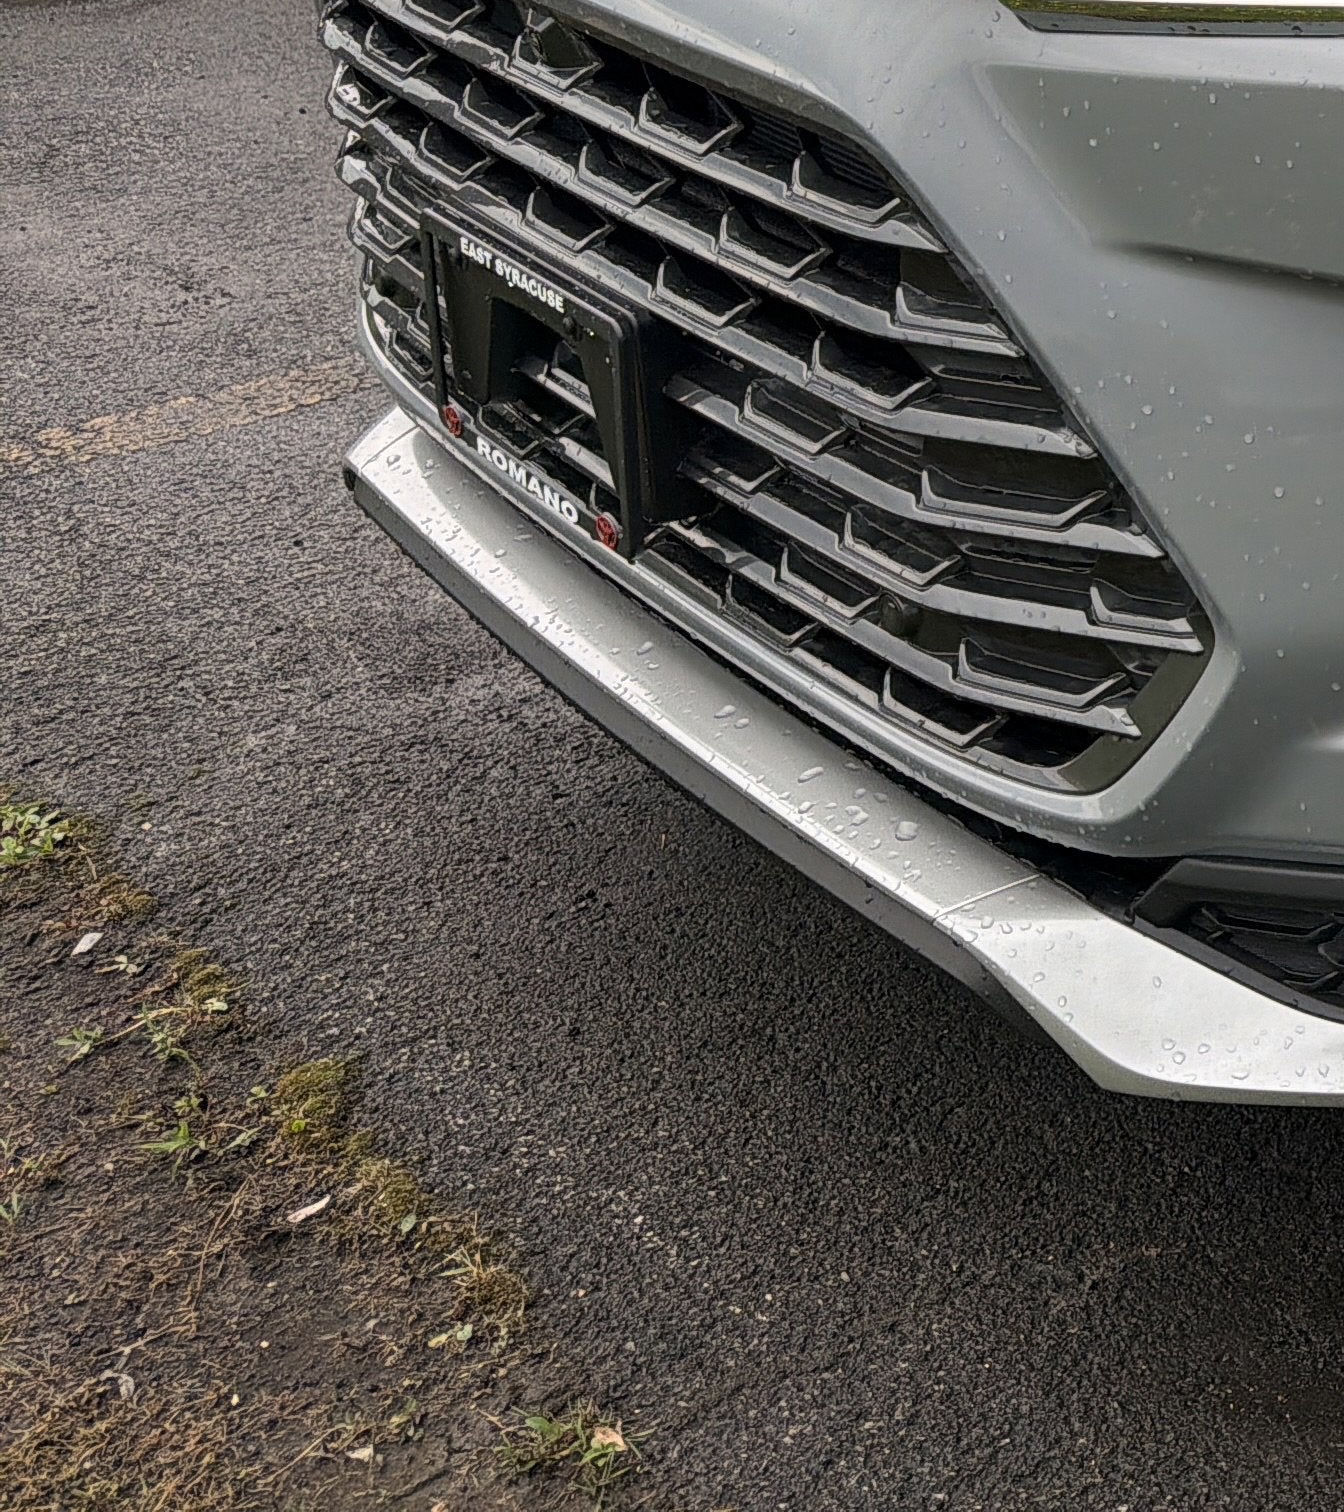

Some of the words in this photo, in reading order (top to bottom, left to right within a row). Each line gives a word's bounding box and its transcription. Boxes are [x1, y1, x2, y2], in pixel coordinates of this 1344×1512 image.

[460, 237, 492, 269] EAST
[495, 259, 565, 314] SYRACUSE
[477, 436, 579, 524] ROMANO
